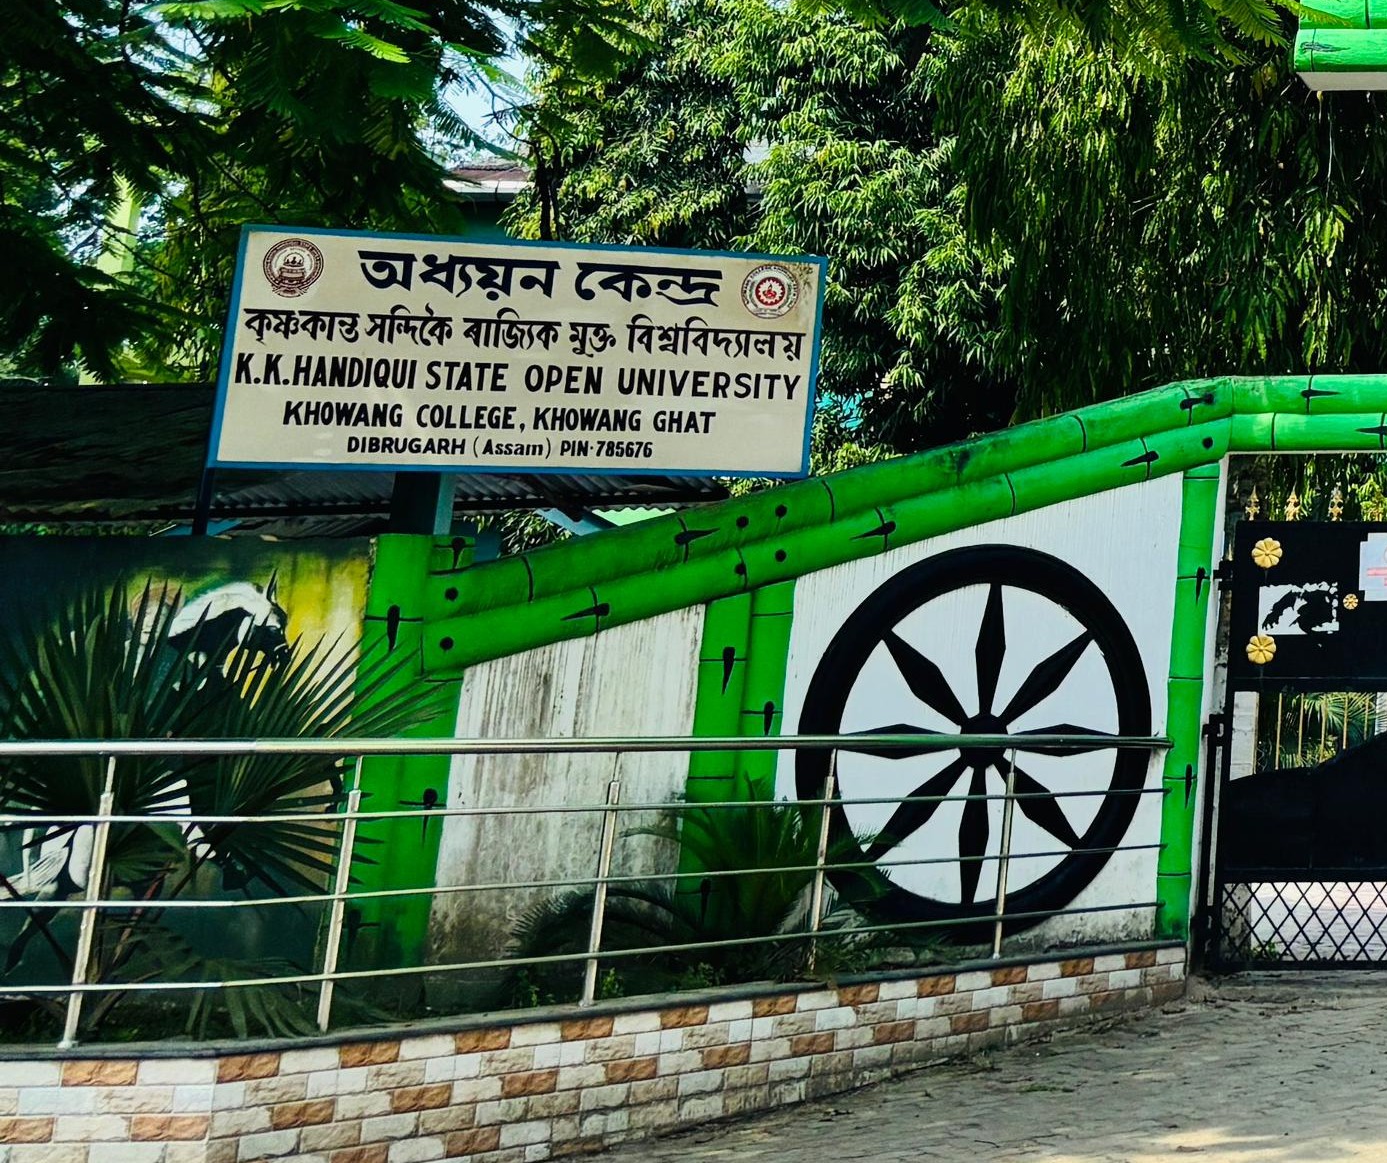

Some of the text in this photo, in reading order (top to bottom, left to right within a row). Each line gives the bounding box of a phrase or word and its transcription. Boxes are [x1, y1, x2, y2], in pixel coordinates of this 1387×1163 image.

[356, 249, 561, 302] অধ্যয়ন
[365, 302, 453, 347] সন্দিকৈ
[569, 321, 618, 358] মুক্ত
[626, 313, 807, 362] বিশ্ববিদ্যালয়
[234, 352, 802, 401] K.K.HANDIQUI STATE OPEN UNIVERSITY
[282, 400, 717, 434] KHOWANG COLLEGE, KHOWANG GHAT
[346, 436, 467, 456] DIBRUGARH
[472, 435, 552, 460] (Assam)
